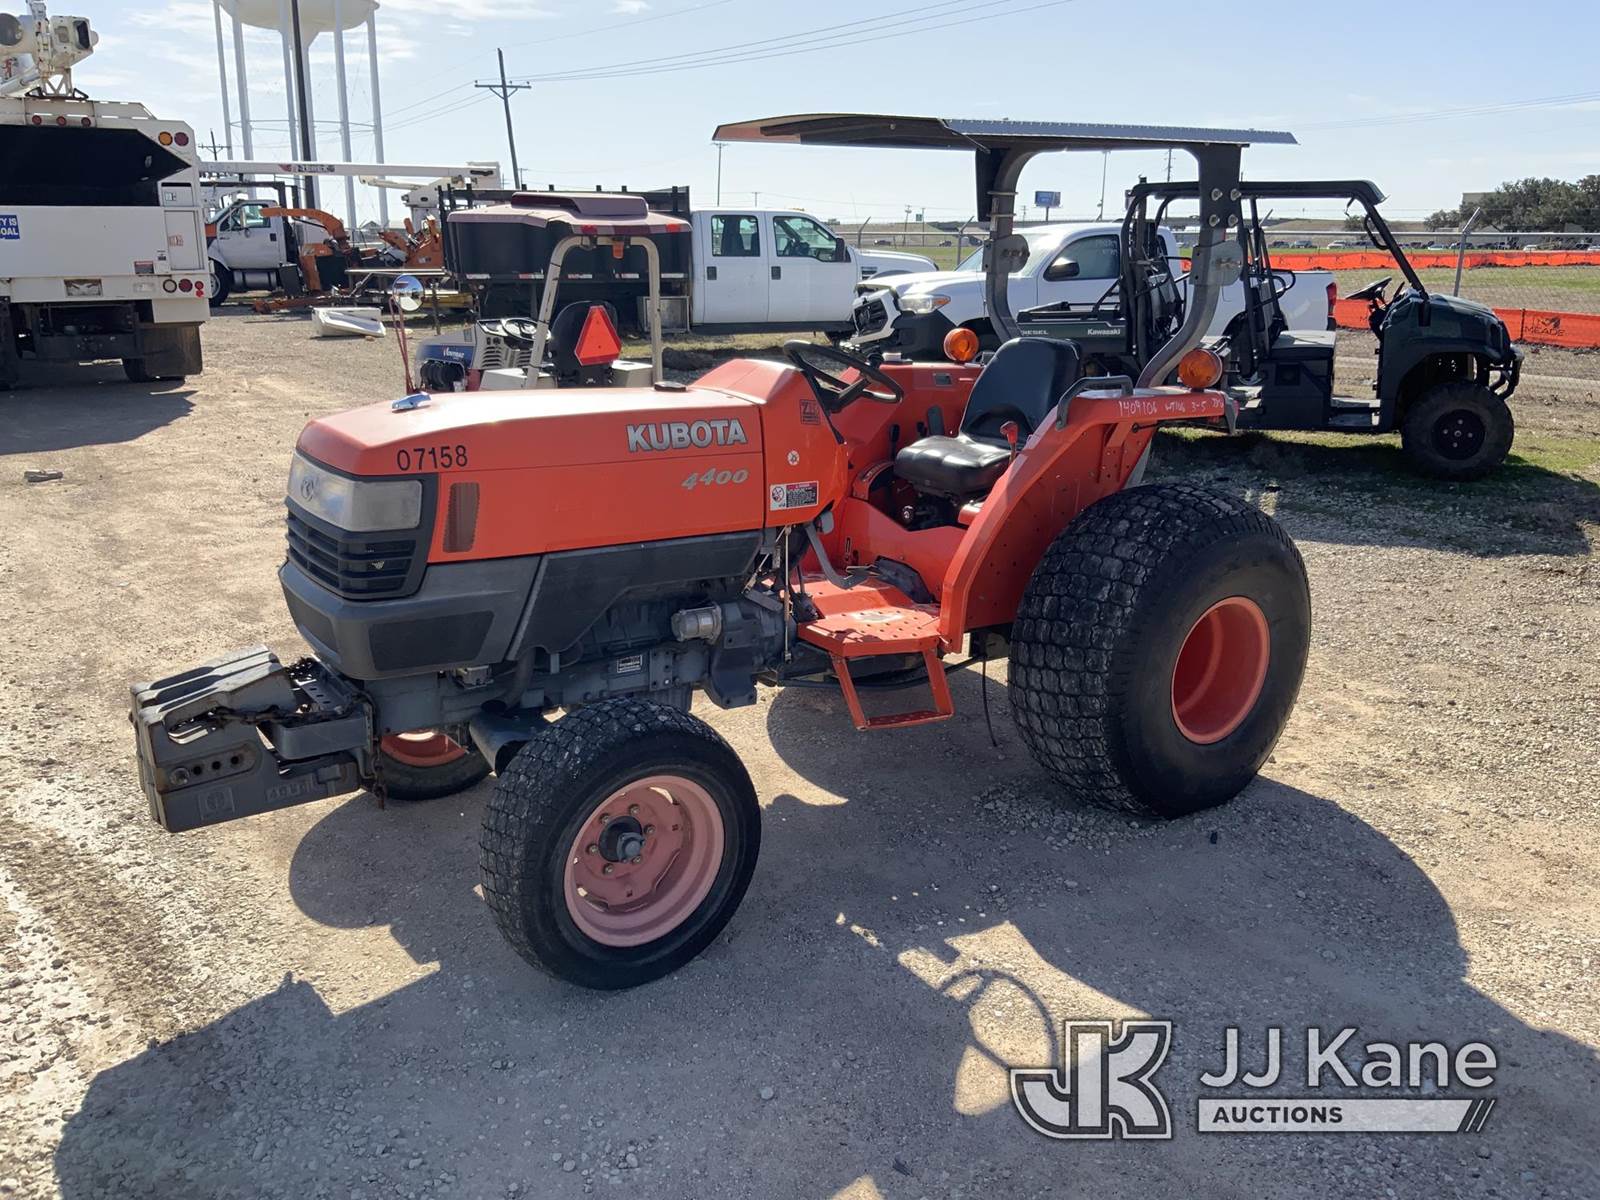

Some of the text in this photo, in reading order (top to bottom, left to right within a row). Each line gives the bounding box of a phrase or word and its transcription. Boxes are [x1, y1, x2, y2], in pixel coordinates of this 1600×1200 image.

[9, 218, 17, 226] IS
[0, 227, 19, 235] OAL
[1087, 328, 1121, 336] Kawasaki
[1524, 326, 1566, 337] MEADE
[1118, 400, 1158, 417] 1409106
[625, 417, 748, 453] KUBOTA
[396, 444, 468, 472] 07158
[680, 467, 750, 490] 4400
